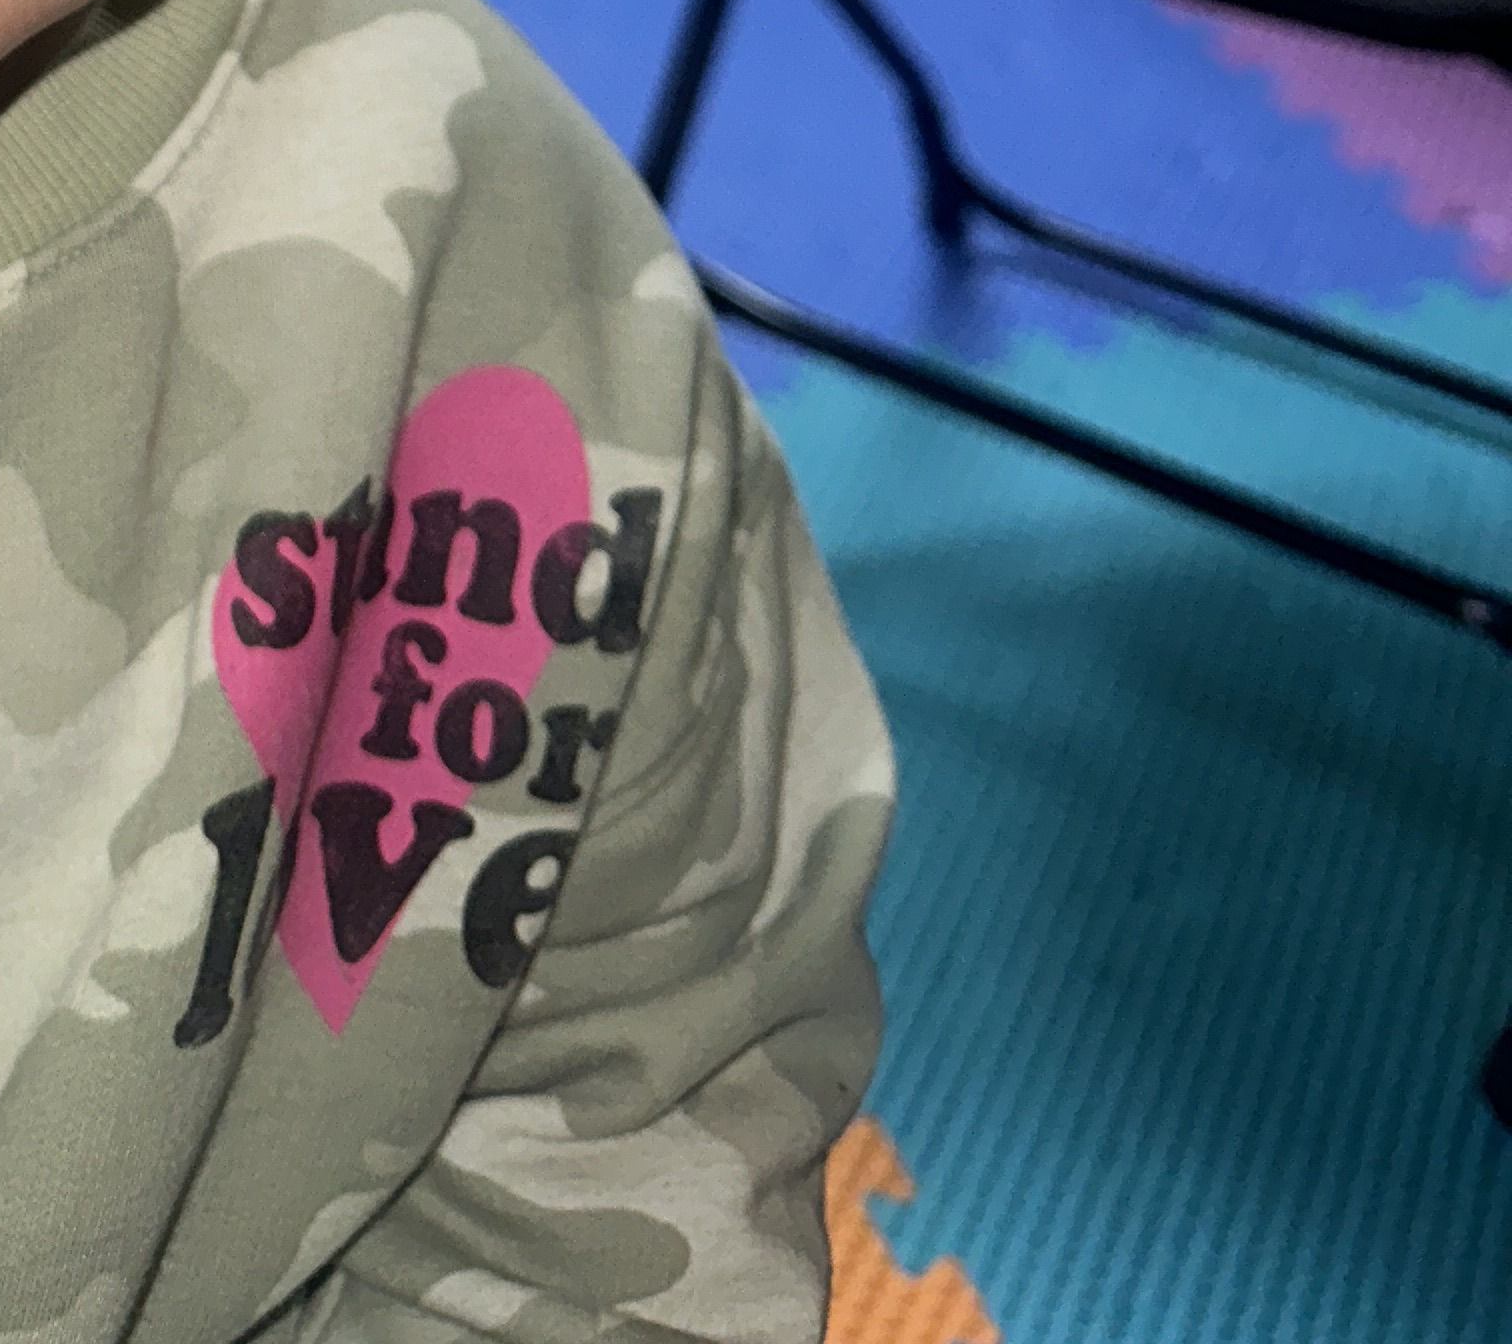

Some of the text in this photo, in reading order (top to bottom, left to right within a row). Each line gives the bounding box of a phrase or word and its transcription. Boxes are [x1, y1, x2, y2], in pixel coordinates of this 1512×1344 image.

[230, 474, 664, 654] stnd
[359, 620, 621, 803] for
[173, 776, 580, 1049] lve
